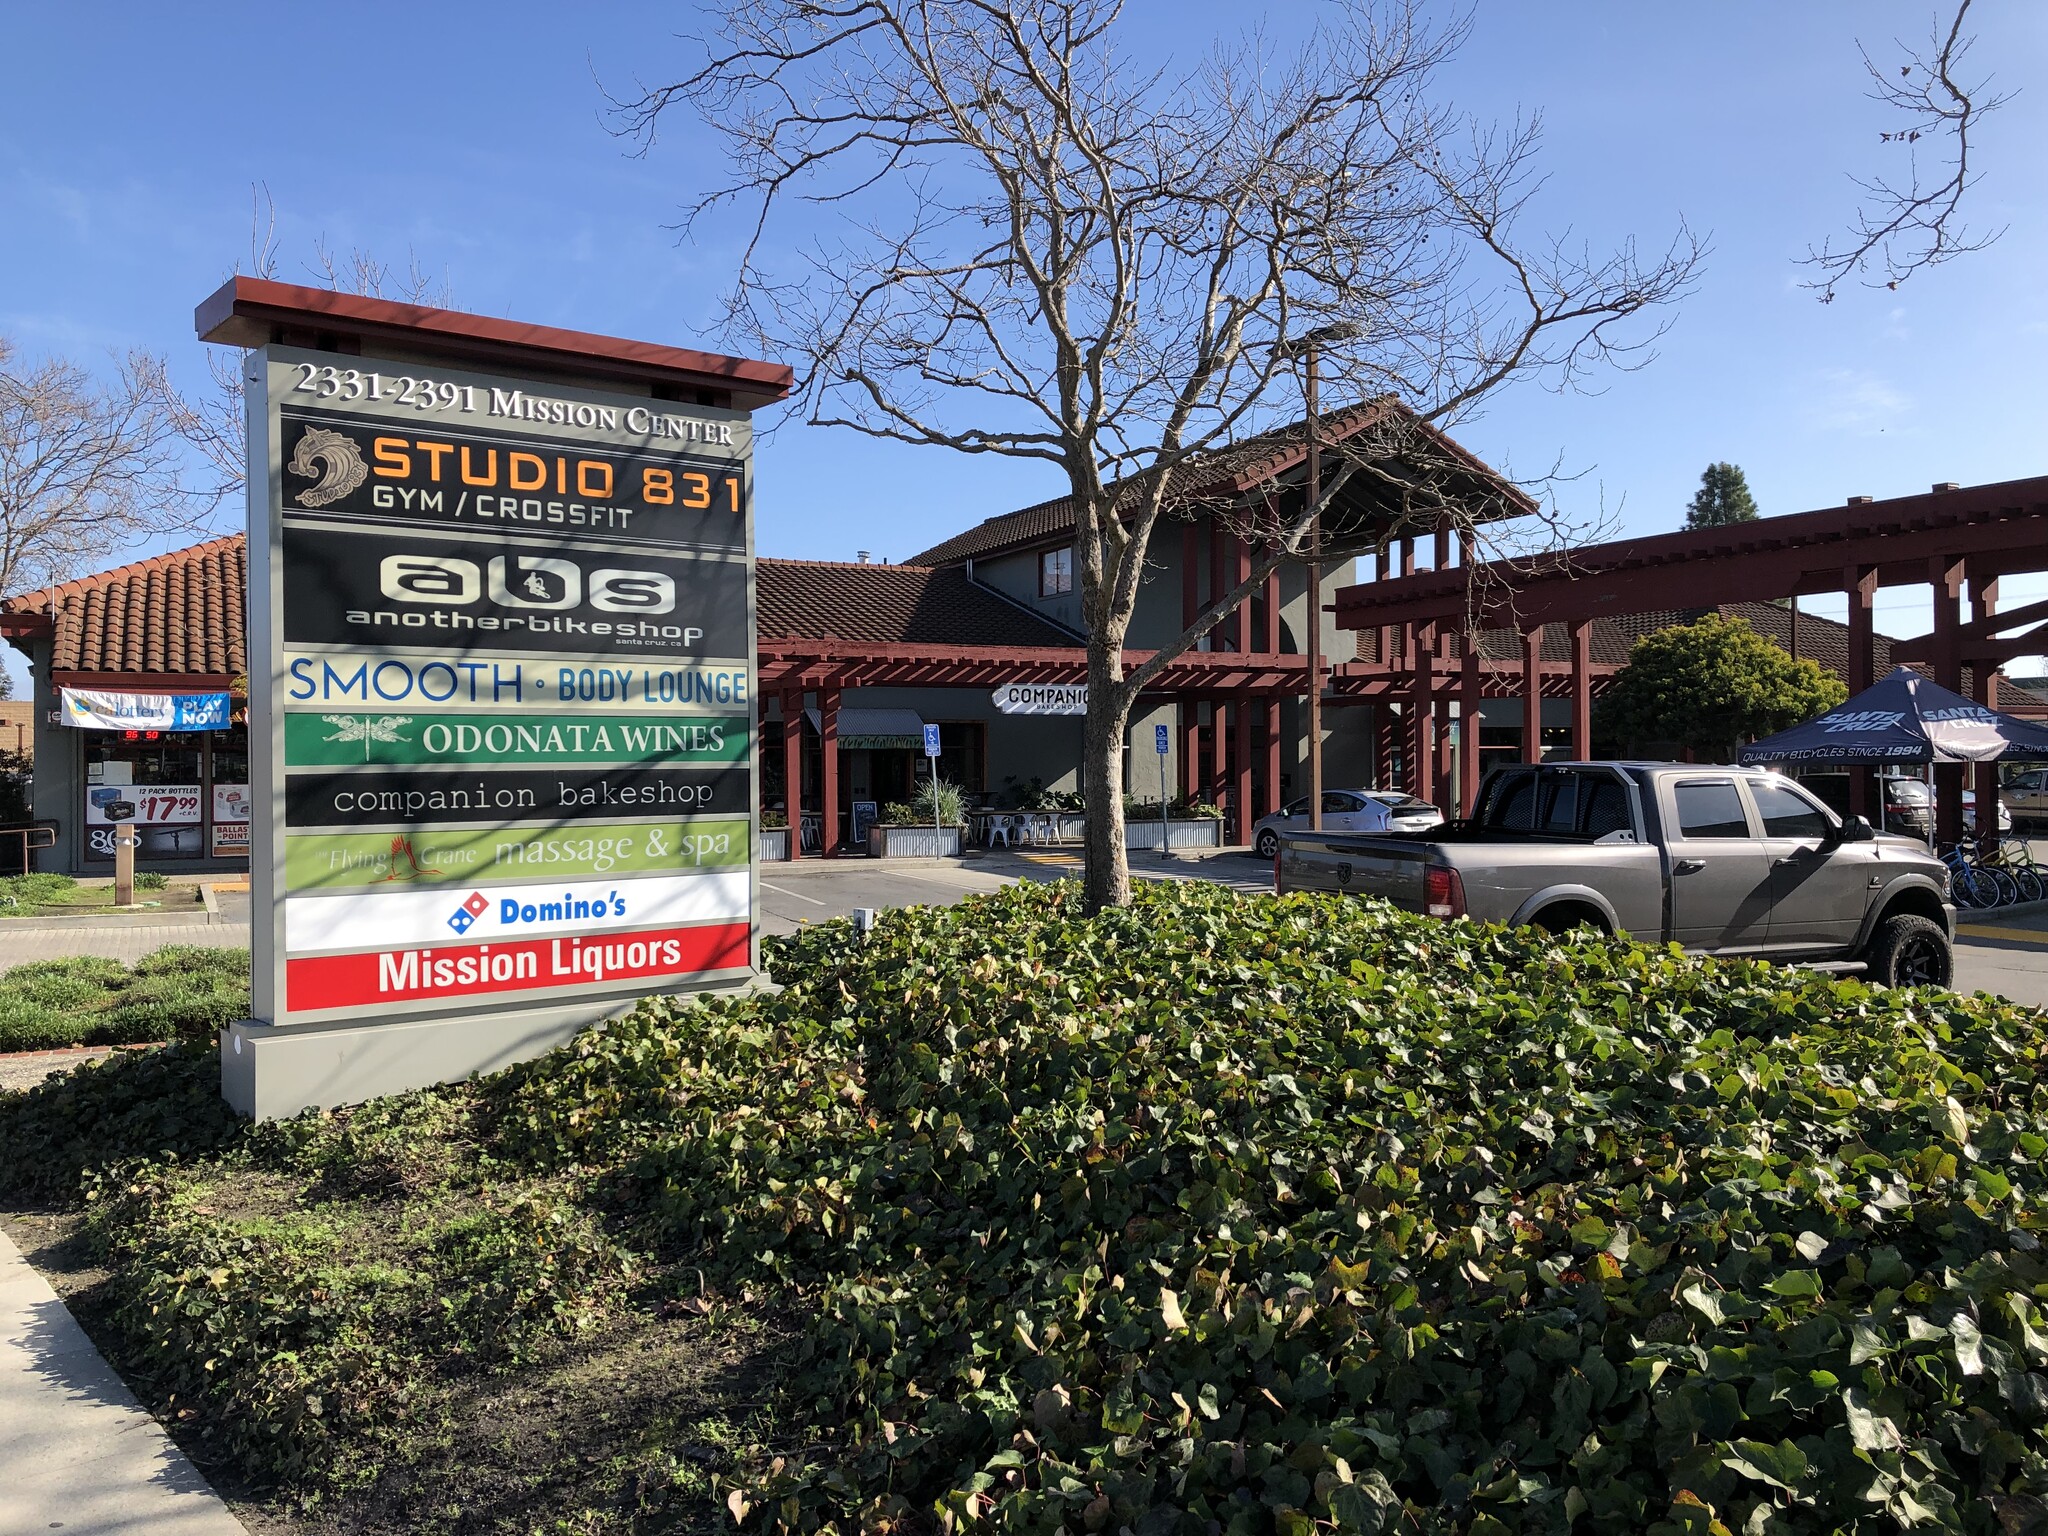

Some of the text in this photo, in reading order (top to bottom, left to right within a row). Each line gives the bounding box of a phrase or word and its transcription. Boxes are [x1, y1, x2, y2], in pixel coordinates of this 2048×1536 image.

[297, 363, 477, 411] 2331-2391
[373, 436, 739, 513] STUDIO 831
[380, 554, 676, 615] abs
[346, 609, 704, 647] anotherbikeshop
[615, 638, 642, 646] santa
[289, 657, 747, 704] SMOOTH BODY LOUNGE
[182, 700, 223, 712] PLAY
[1008, 687, 1088, 704] COMPANI
[182, 710, 223, 725] NOW
[1816, 711, 1905, 725] SANTA
[1922, 706, 1994, 721] SANTA
[1949, 716, 2003, 729] CRUZ
[422, 723, 724, 753] ODONATA WINES
[1824, 720, 1894, 733] CRUZ
[1742, 745, 1923, 763] QUALITY BICYCLES SINCE 1994
[168, 787, 198, 795] BOTTLES
[334, 779, 714, 817] companion bakeshop
[329, 849, 387, 876] Flying
[421, 846, 477, 866] Crane
[495, 832, 633, 872] massage
[645, 829, 668, 856] &
[681, 830, 731, 867] spa
[500, 890, 626, 924] Domino's
[378, 937, 682, 992] Mission Liquors
